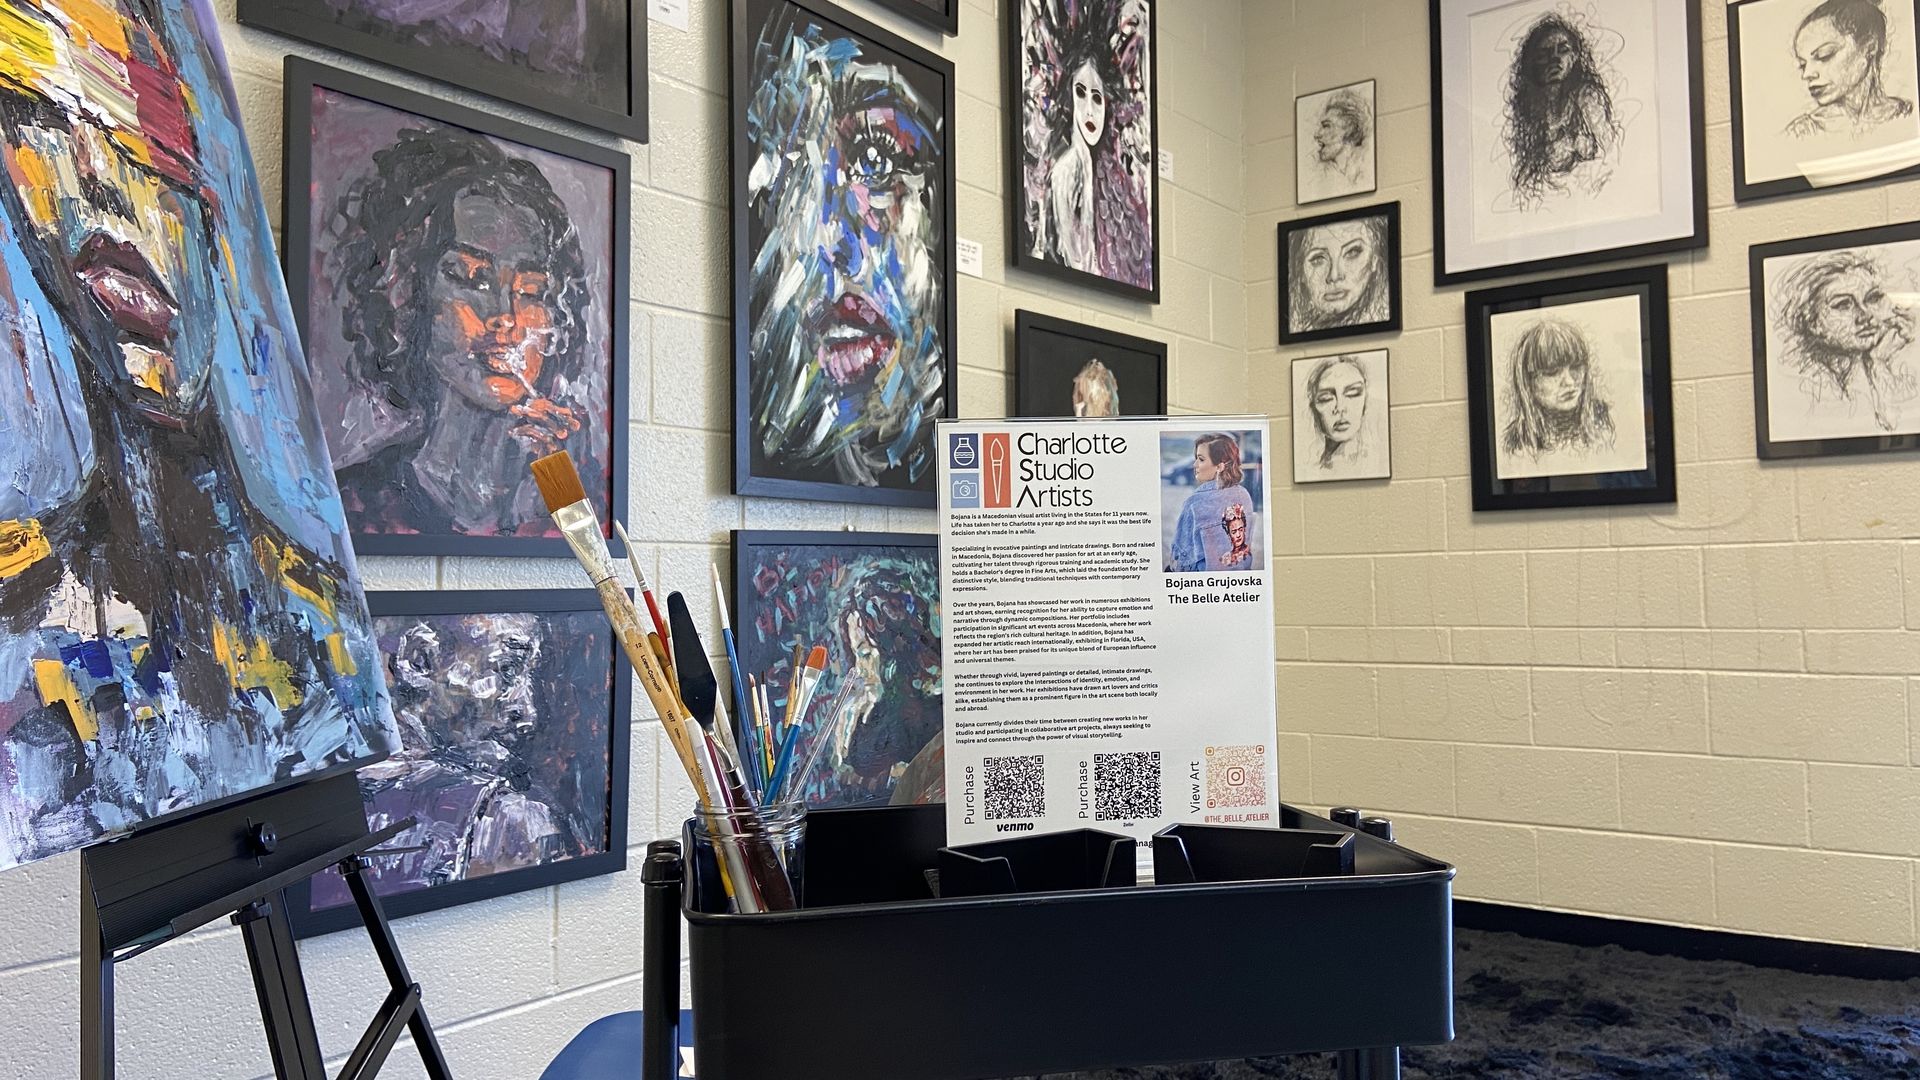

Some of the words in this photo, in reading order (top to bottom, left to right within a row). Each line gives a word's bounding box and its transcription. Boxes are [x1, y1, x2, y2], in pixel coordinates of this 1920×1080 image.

[1018, 432, 1127, 455] Charlotte
[1020, 458, 1094, 481] Studio
[1016, 485, 1093, 508] Artists
[1166, 578, 1204, 590] Bojana
[1207, 576, 1262, 589] Grujovska
[1168, 594, 1189, 604] The
[1192, 593, 1220, 603] Belle
[1223, 592, 1260, 602] Atelier
[987, 728, 1023, 736] participating
[1190, 761, 1199, 781] Art
[964, 766, 975, 824] Purchase
[1078, 760, 1088, 818] Purchase
[1190, 785, 1200, 814] View
[997, 822, 1034, 832] venmo
[1205, 813, 1269, 823] @THE_BELLE_ATELIER
